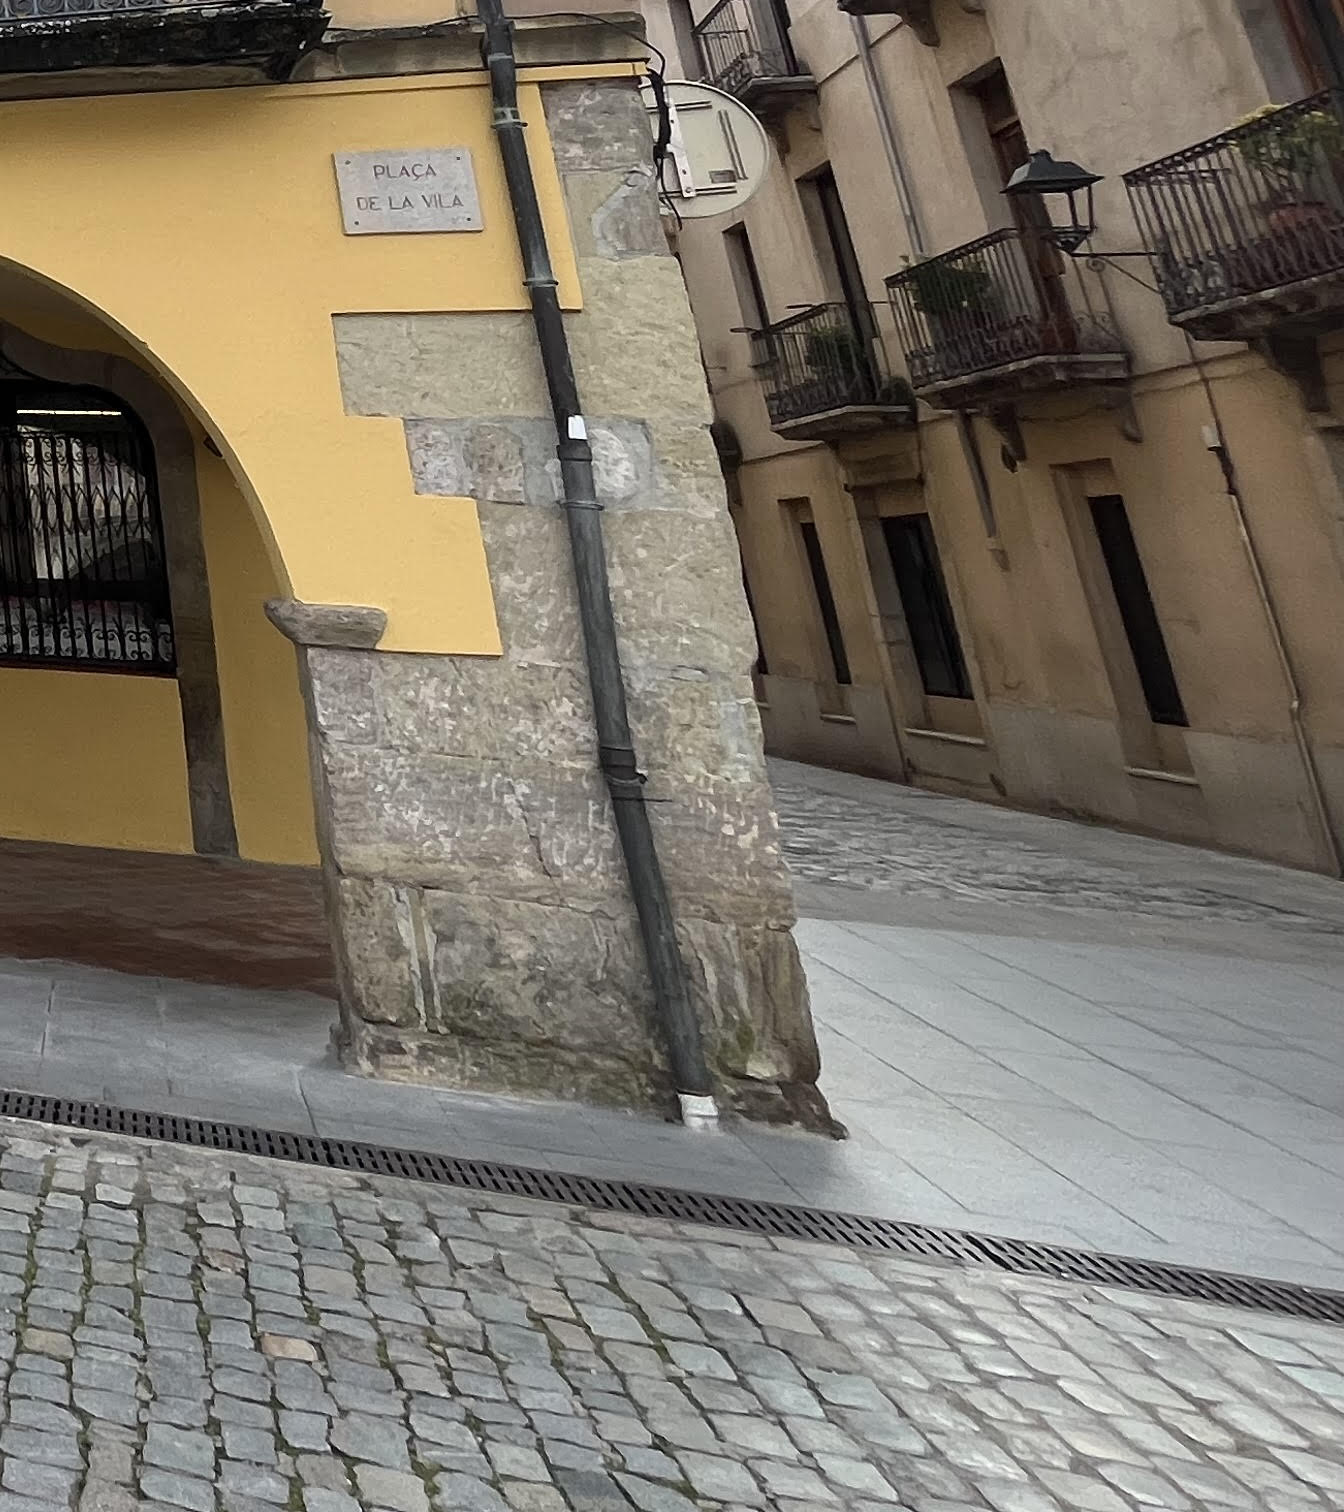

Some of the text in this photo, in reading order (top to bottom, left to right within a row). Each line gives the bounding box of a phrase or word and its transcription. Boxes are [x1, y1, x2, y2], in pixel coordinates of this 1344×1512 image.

[372, 163, 437, 181] PLAÇA
[356, 193, 464, 211] DE LA VILA
